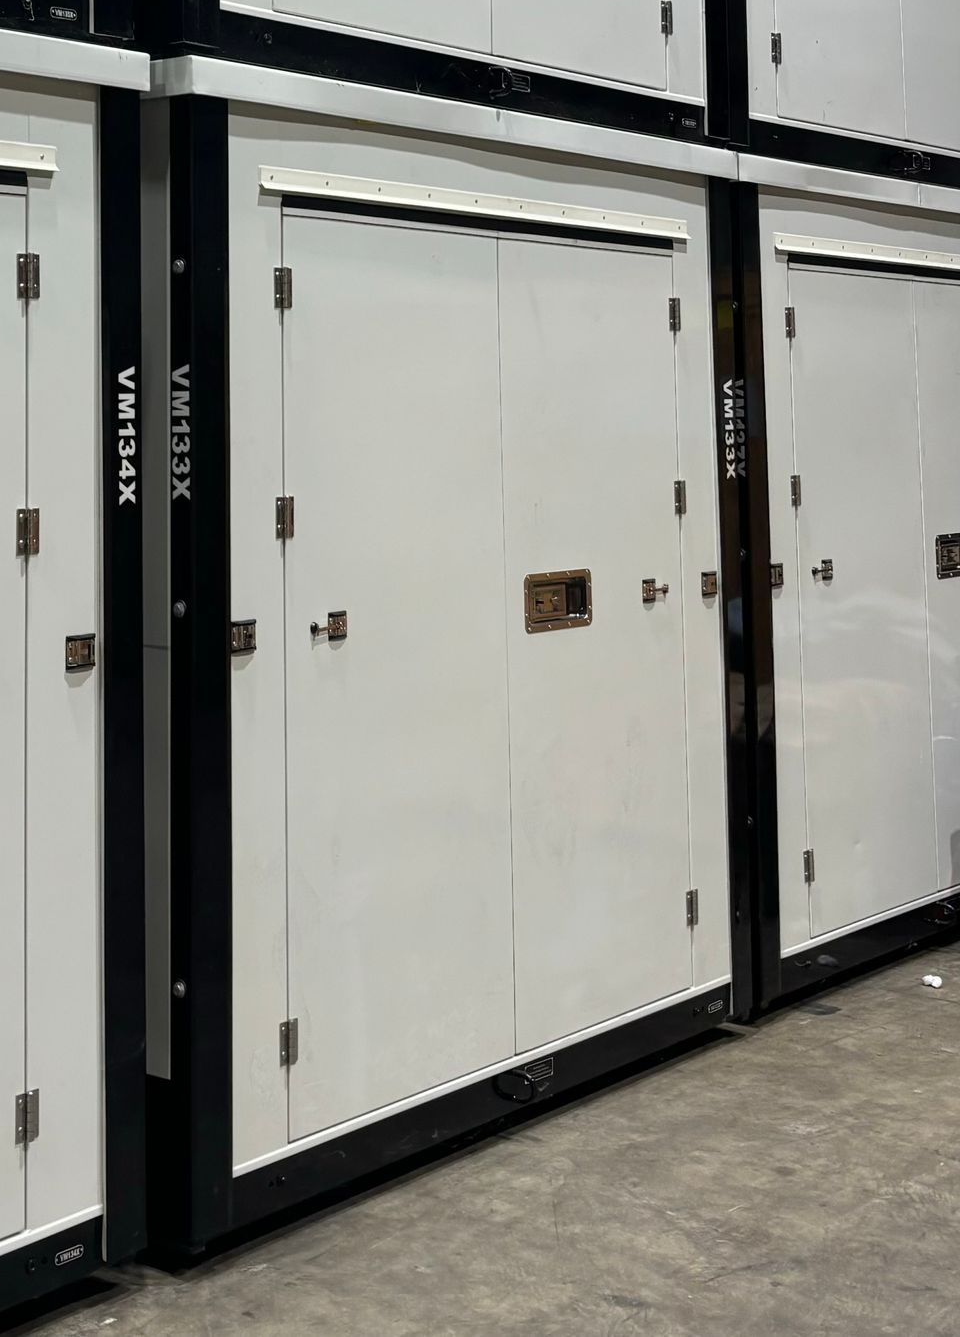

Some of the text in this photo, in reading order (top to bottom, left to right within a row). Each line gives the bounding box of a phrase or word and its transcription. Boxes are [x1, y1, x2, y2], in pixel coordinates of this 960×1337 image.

[118, 366, 136, 506] VM134X
[171, 364, 191, 500] VM133X
[723, 379, 736, 480] VM133X
